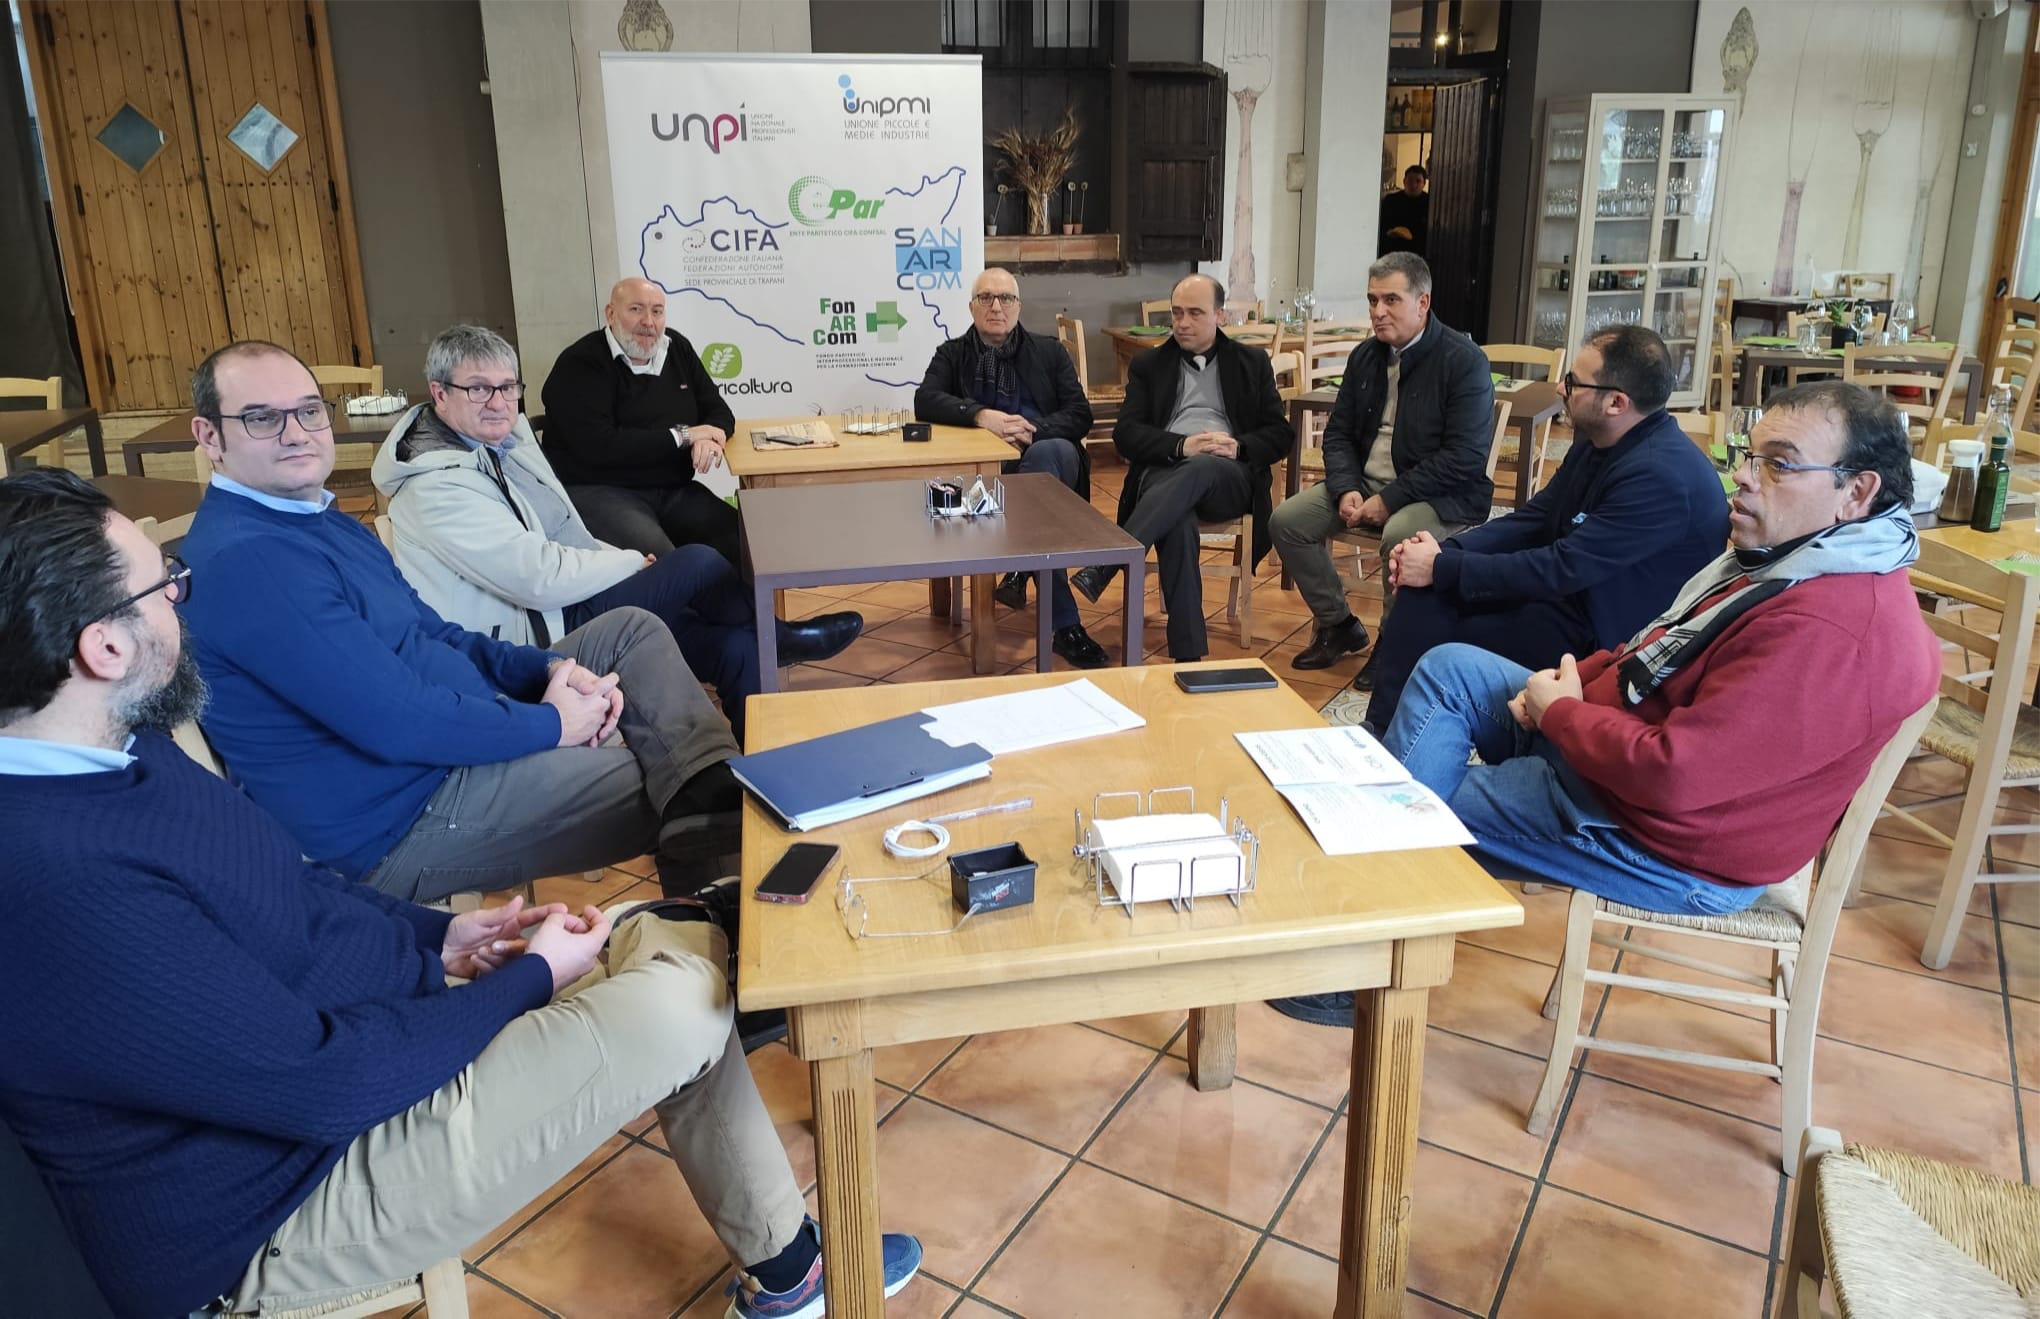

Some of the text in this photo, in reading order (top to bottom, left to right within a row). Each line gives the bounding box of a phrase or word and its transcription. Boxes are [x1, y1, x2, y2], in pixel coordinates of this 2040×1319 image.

[844, 119, 879, 129] UNIONE
[884, 119, 920, 129] PICCOLE
[844, 130, 931, 140] MEDIE INDUSTRIE
[710, 229, 780, 252] CIFA
[895, 226, 962, 248] SAN
[682, 254, 784, 264] CONFEDERAZIONE ITALIANA
[904, 249, 952, 271] AR
[683, 263, 785, 273] FEDERAZIONI AUTONOME
[684, 276, 785, 287] SEDE PROVINCIALE DI TRAPANI
[896, 271, 962, 291] COM
[820, 297, 856, 315] Fon
[830, 315, 857, 332] AR
[813, 329, 858, 346] Com
[717, 377, 793, 396] ricoltura
